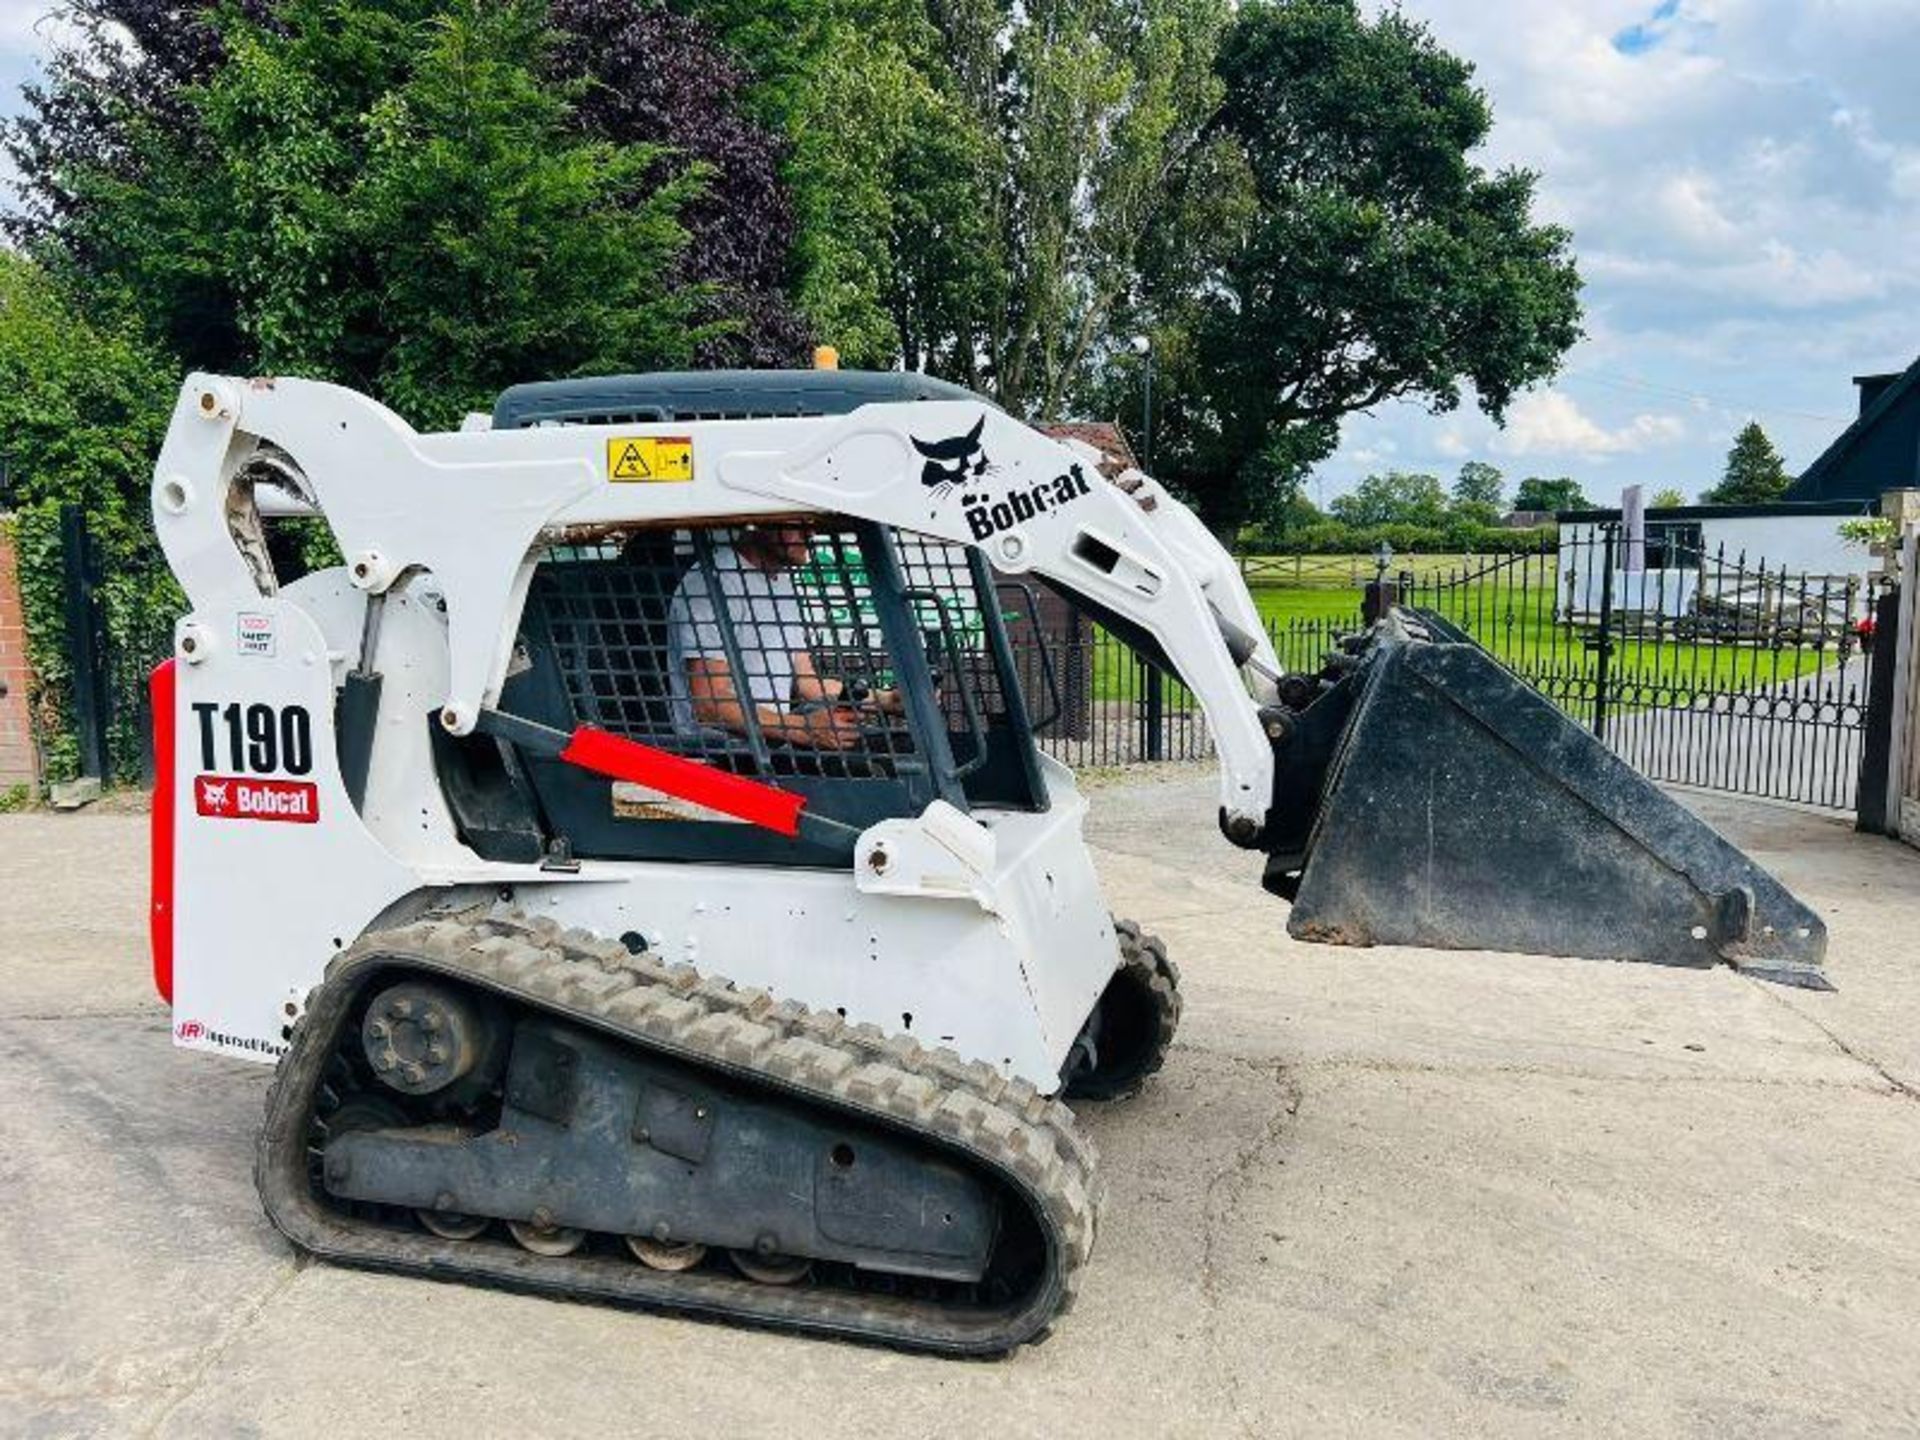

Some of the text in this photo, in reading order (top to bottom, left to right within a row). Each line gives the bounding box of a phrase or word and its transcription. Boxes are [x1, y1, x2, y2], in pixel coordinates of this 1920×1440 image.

[964, 463, 1091, 542] Bobcat
[191, 702, 313, 776] T190
[237, 786, 310, 814] Bobcat
